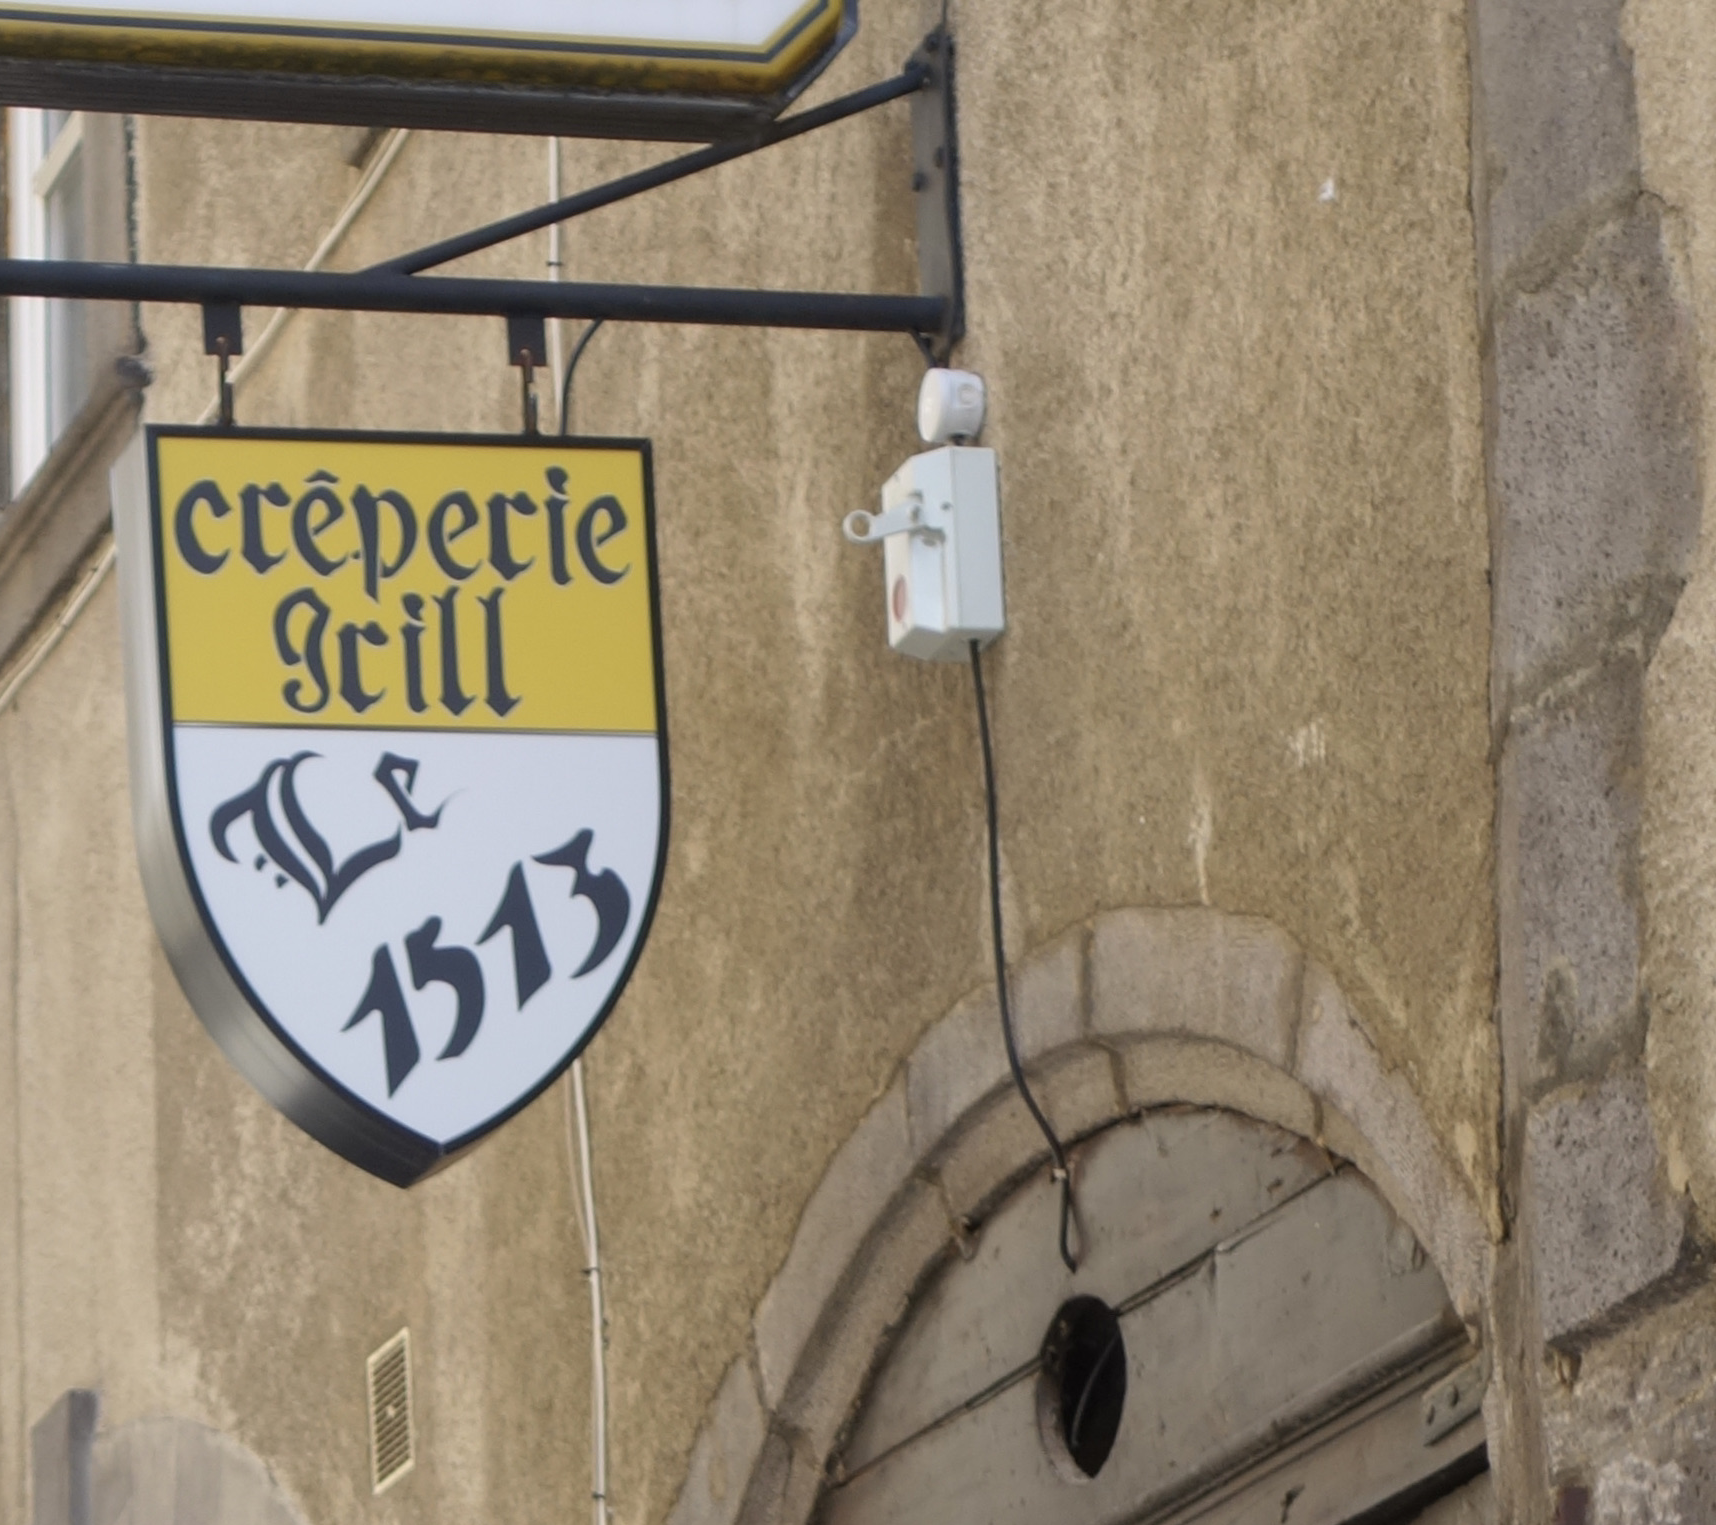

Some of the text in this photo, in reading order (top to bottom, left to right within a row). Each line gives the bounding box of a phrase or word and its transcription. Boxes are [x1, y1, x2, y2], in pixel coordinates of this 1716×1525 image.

[173, 465, 633, 602] crêperie
[208, 750, 468, 926] Le
[339, 828, 631, 1099] 1513
